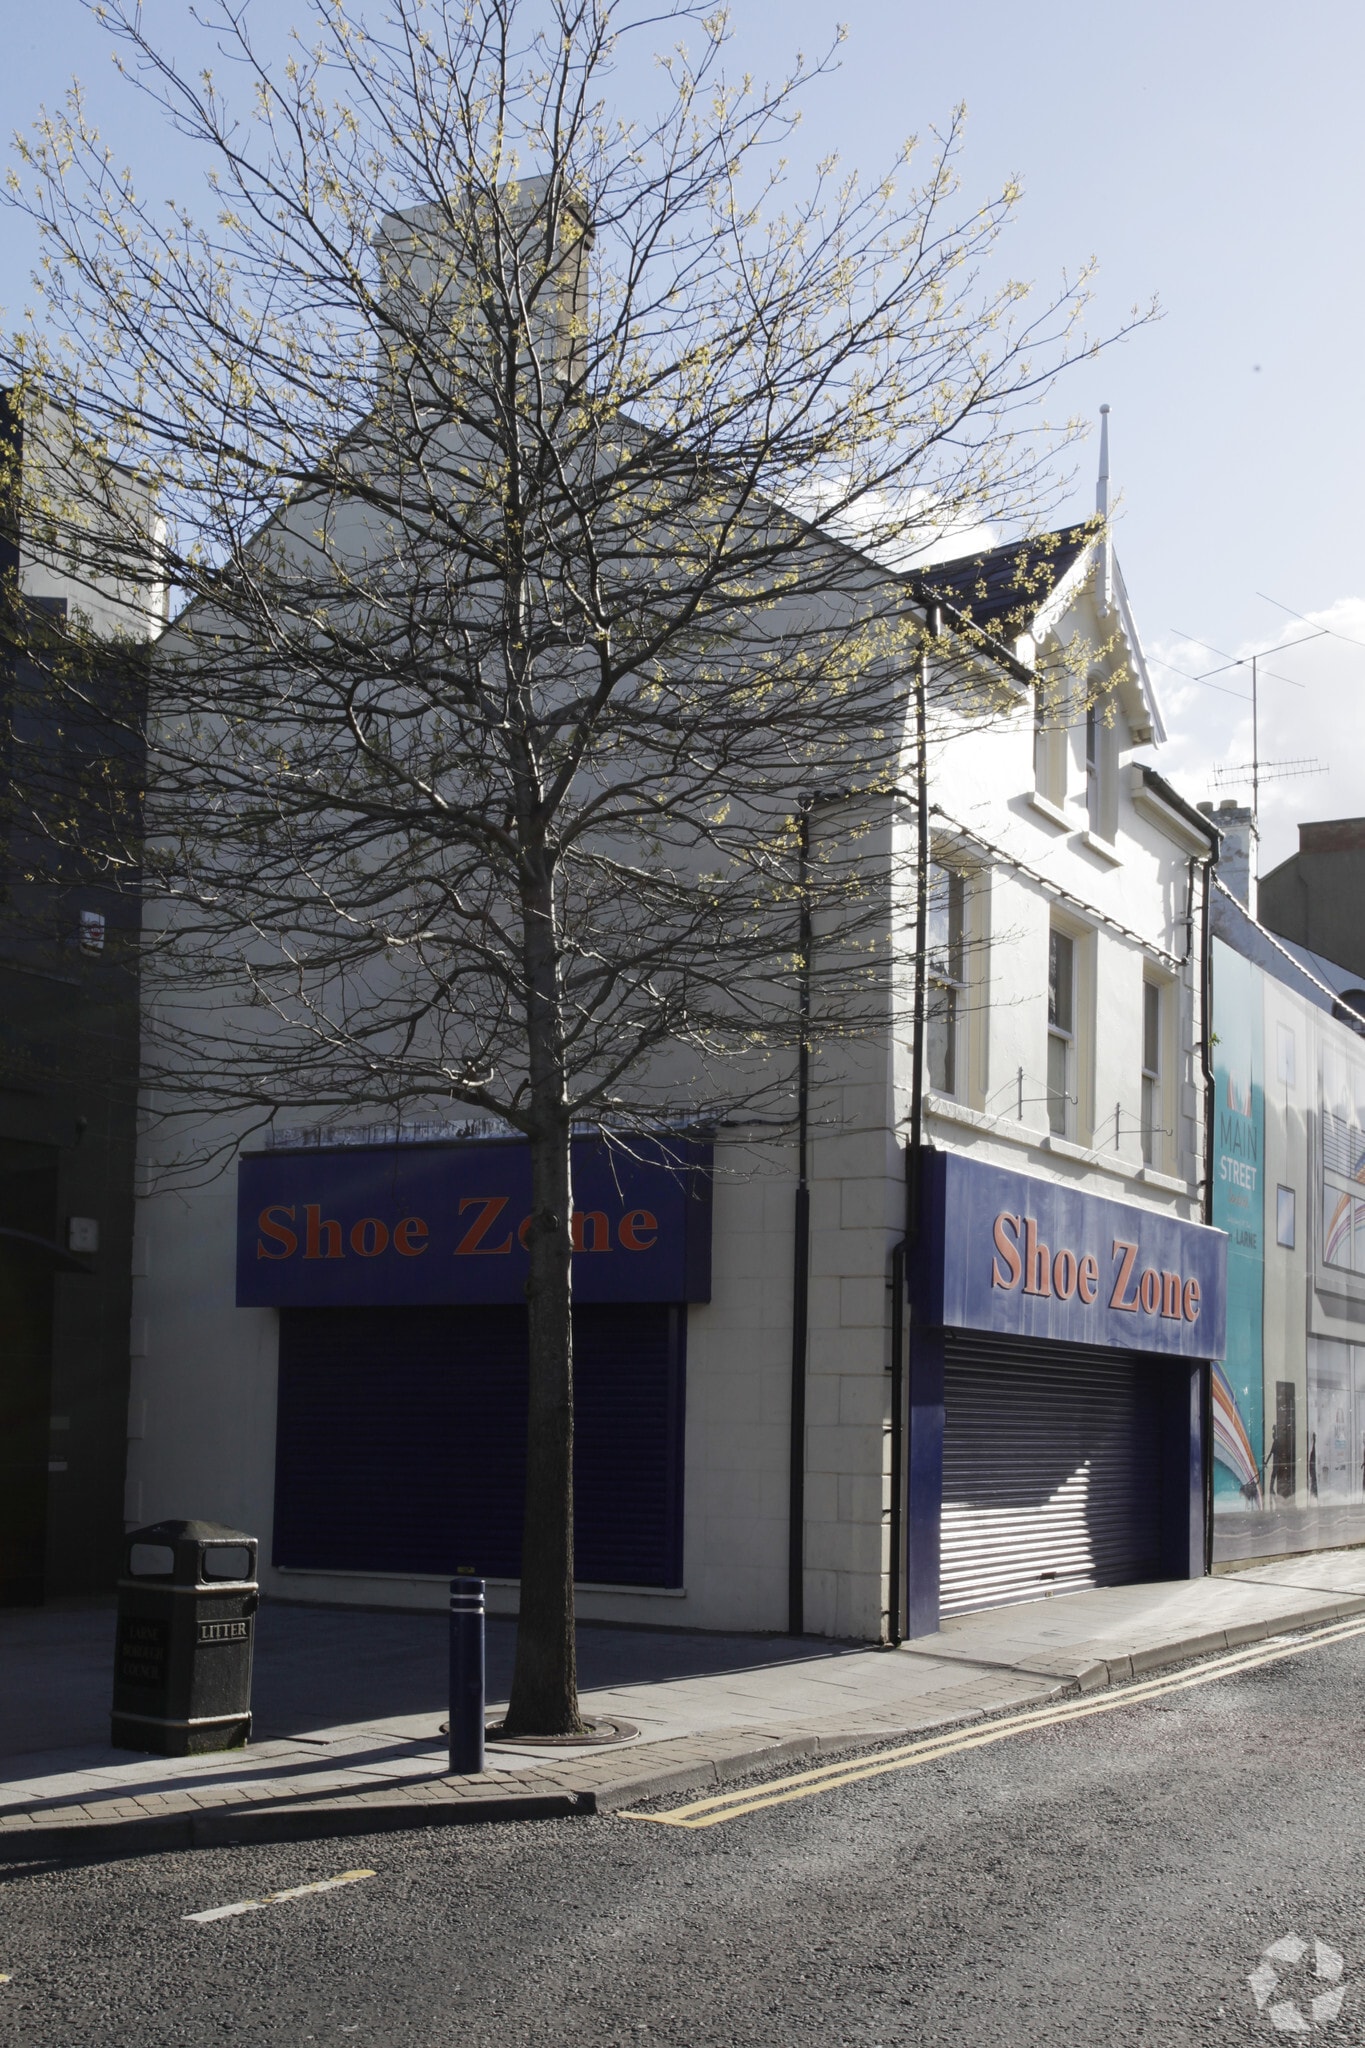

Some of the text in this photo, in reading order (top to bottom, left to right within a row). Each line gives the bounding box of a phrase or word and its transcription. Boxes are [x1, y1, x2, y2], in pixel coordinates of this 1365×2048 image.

[1220, 1111, 1257, 1163] MAIN
[1220, 1154, 1257, 1192] STREET
[256, 1204, 430, 1260] Shoe
[1236, 1228, 1257, 1250] LARNE
[991, 1211, 1202, 1323] Shoe Zone
[200, 1622, 247, 1640] LITTER
